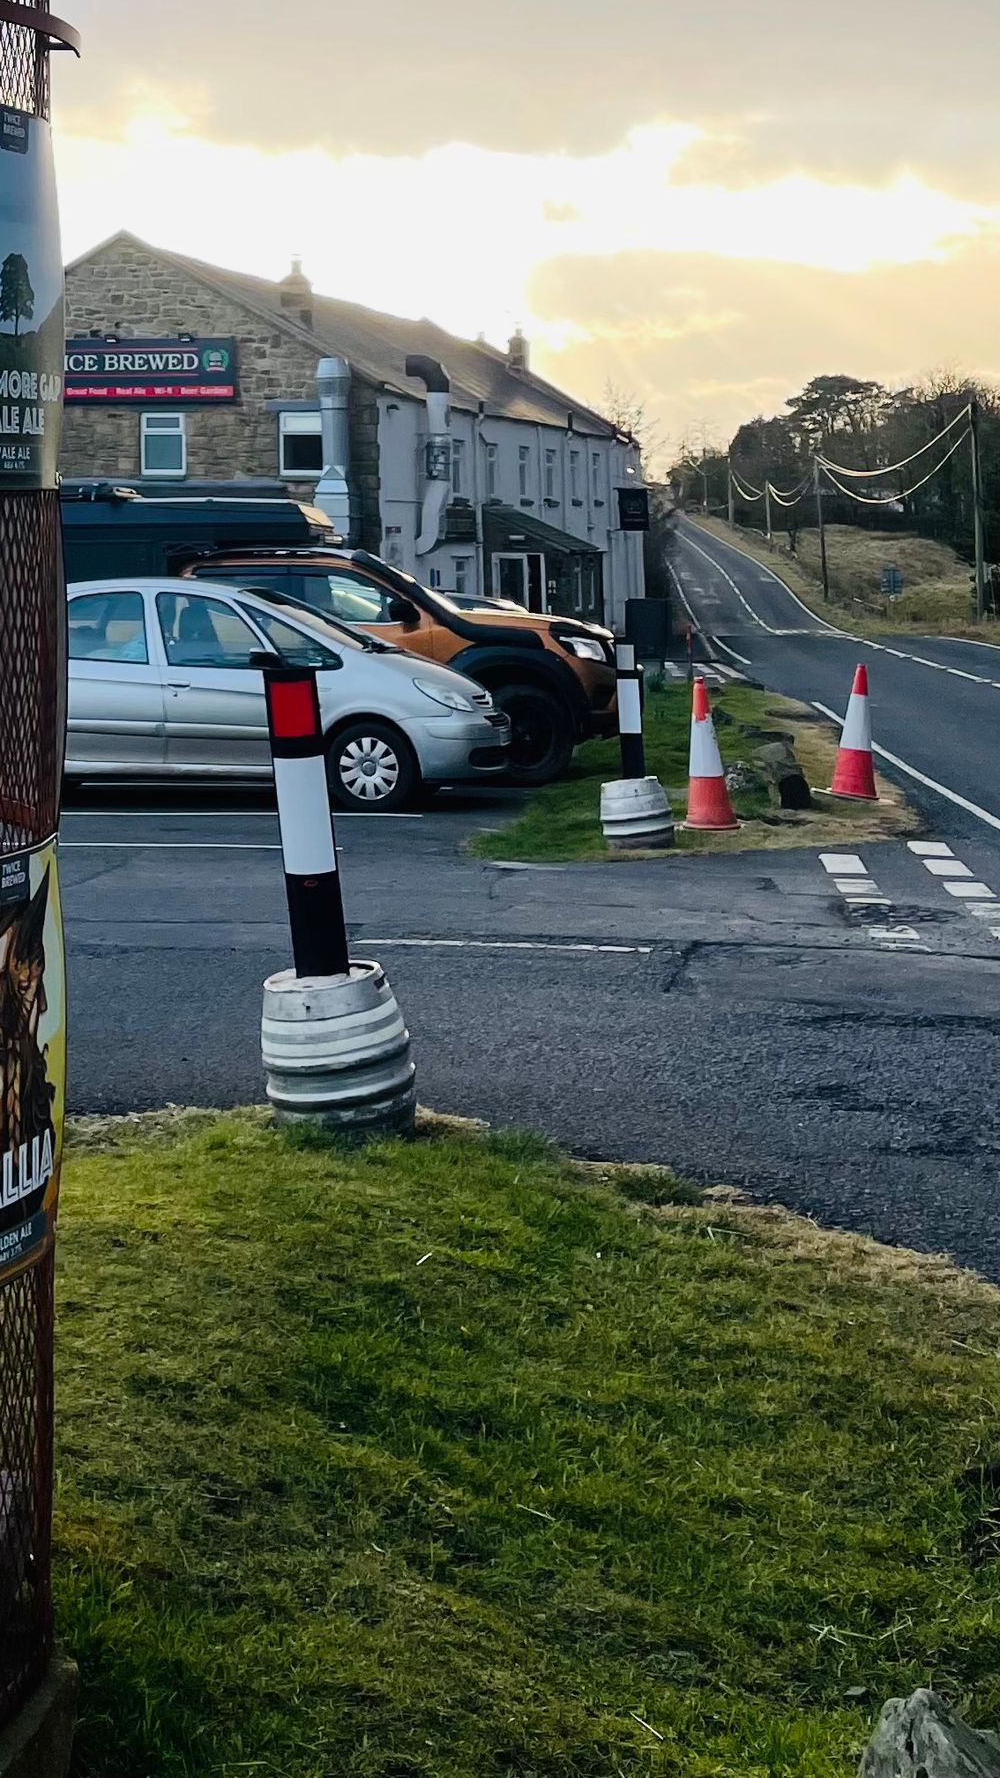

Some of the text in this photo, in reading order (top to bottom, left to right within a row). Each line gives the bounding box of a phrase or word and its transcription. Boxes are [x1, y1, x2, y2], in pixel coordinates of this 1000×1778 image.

[104, 353, 199, 371] BREWED
[40, 373, 61, 402] GAP
[22, 407, 45, 435] ALE
[17, 446, 31, 460] ALE
[2, 860, 21, 876] TWICE
[1, 871, 26, 889] BREWED
[20, 1221, 32, 1241] ALE
